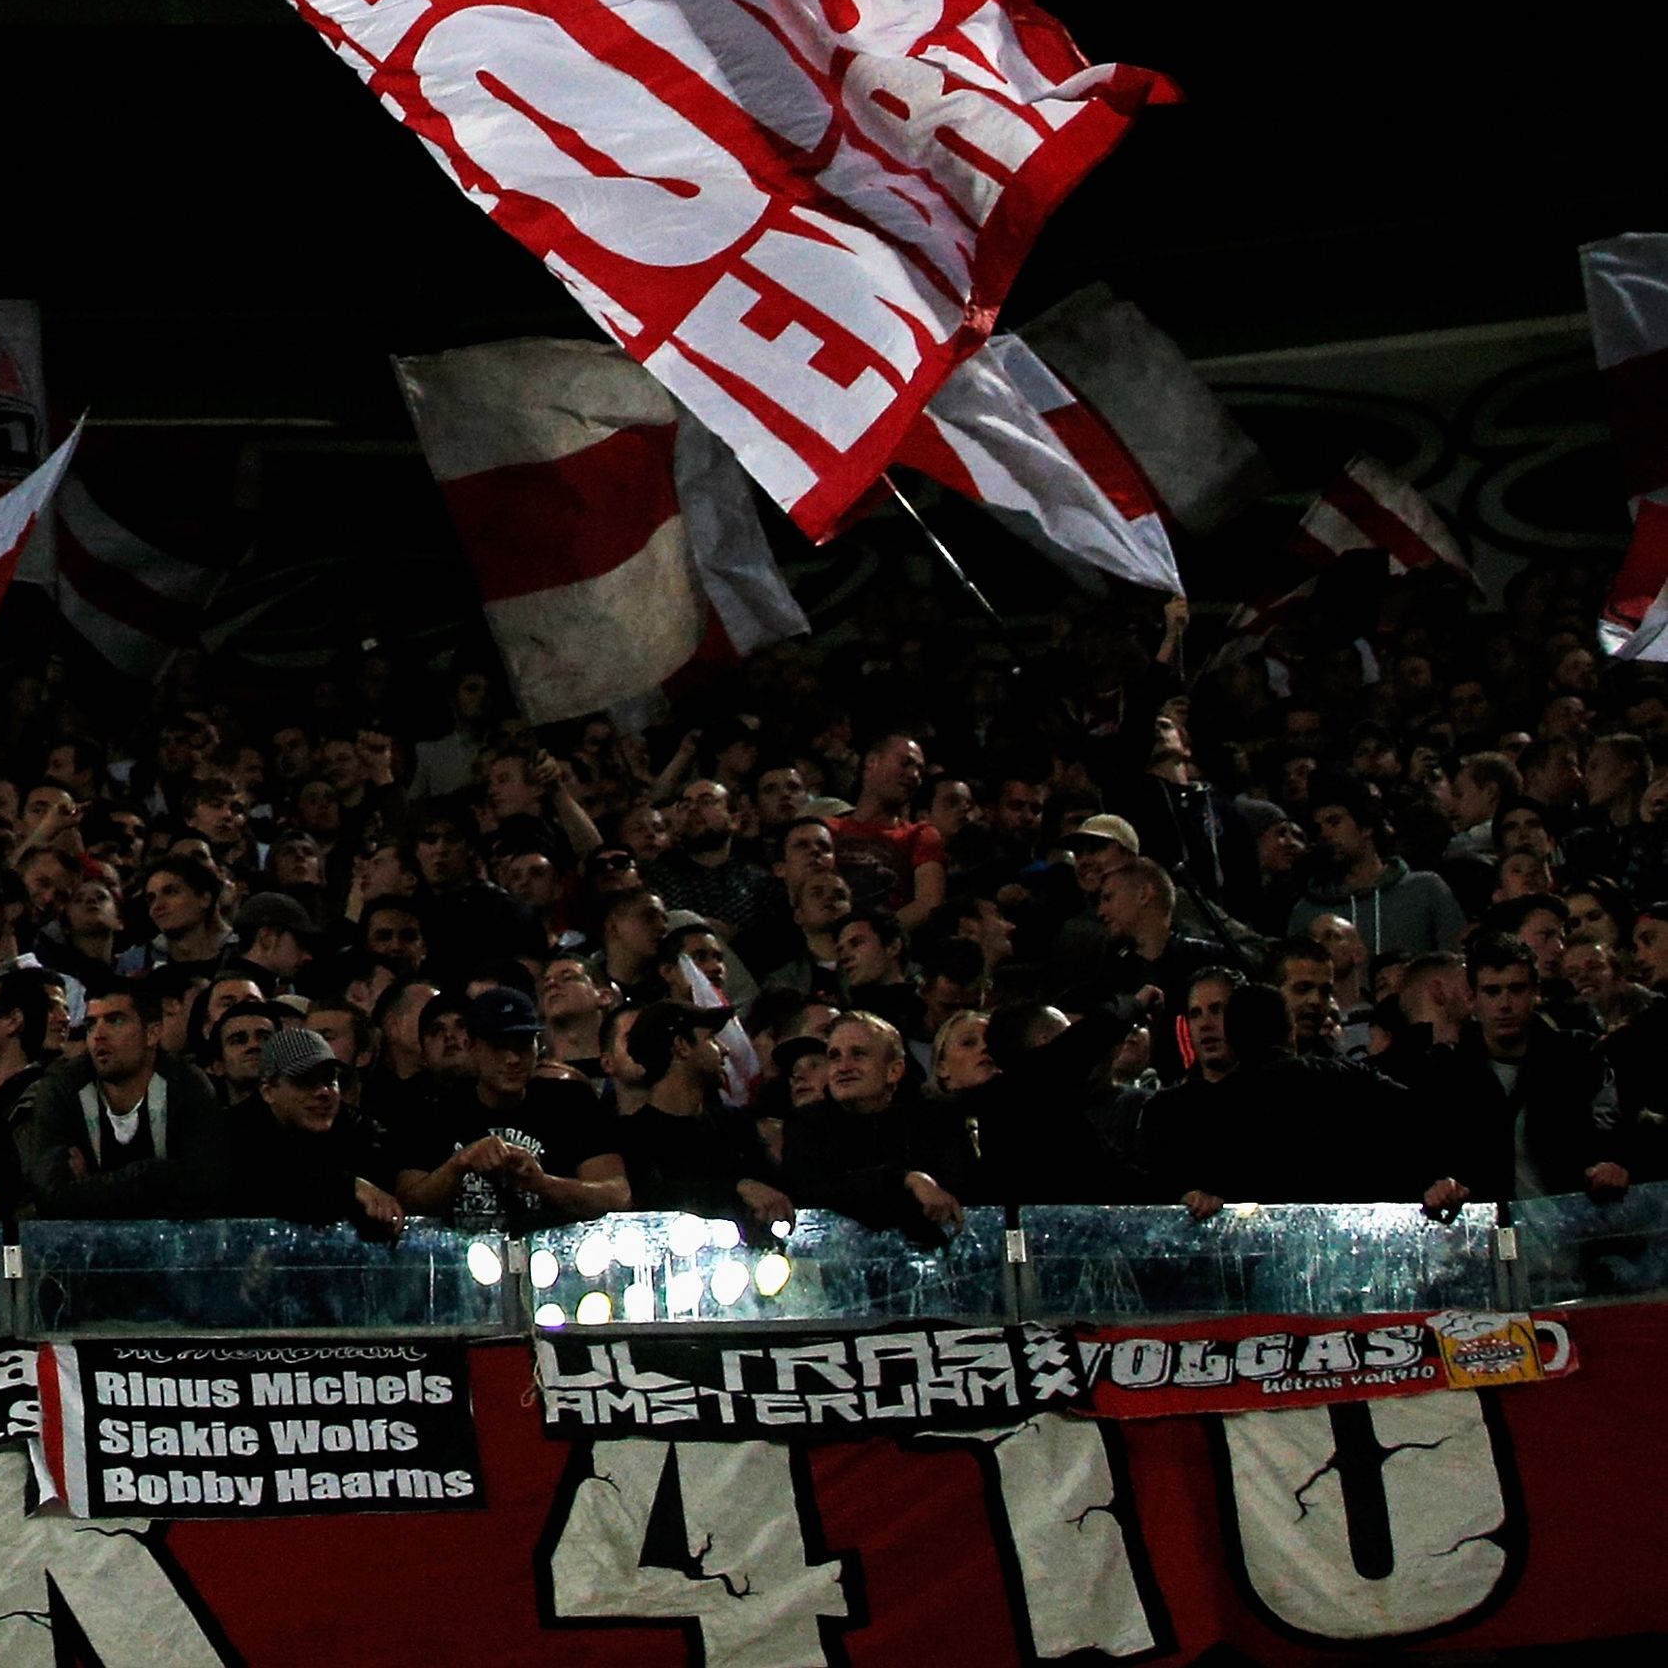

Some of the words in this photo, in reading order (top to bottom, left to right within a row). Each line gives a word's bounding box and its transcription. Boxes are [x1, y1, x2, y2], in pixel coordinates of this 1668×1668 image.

[94, 1370, 240, 1408] Rinus
[251, 1369, 454, 1406] Michels
[97, 1417, 260, 1458] Sjakie
[268, 1417, 419, 1456] Wolfs
[102, 1466, 264, 1507] Bobby
[274, 1467, 475, 1504] Haarms
